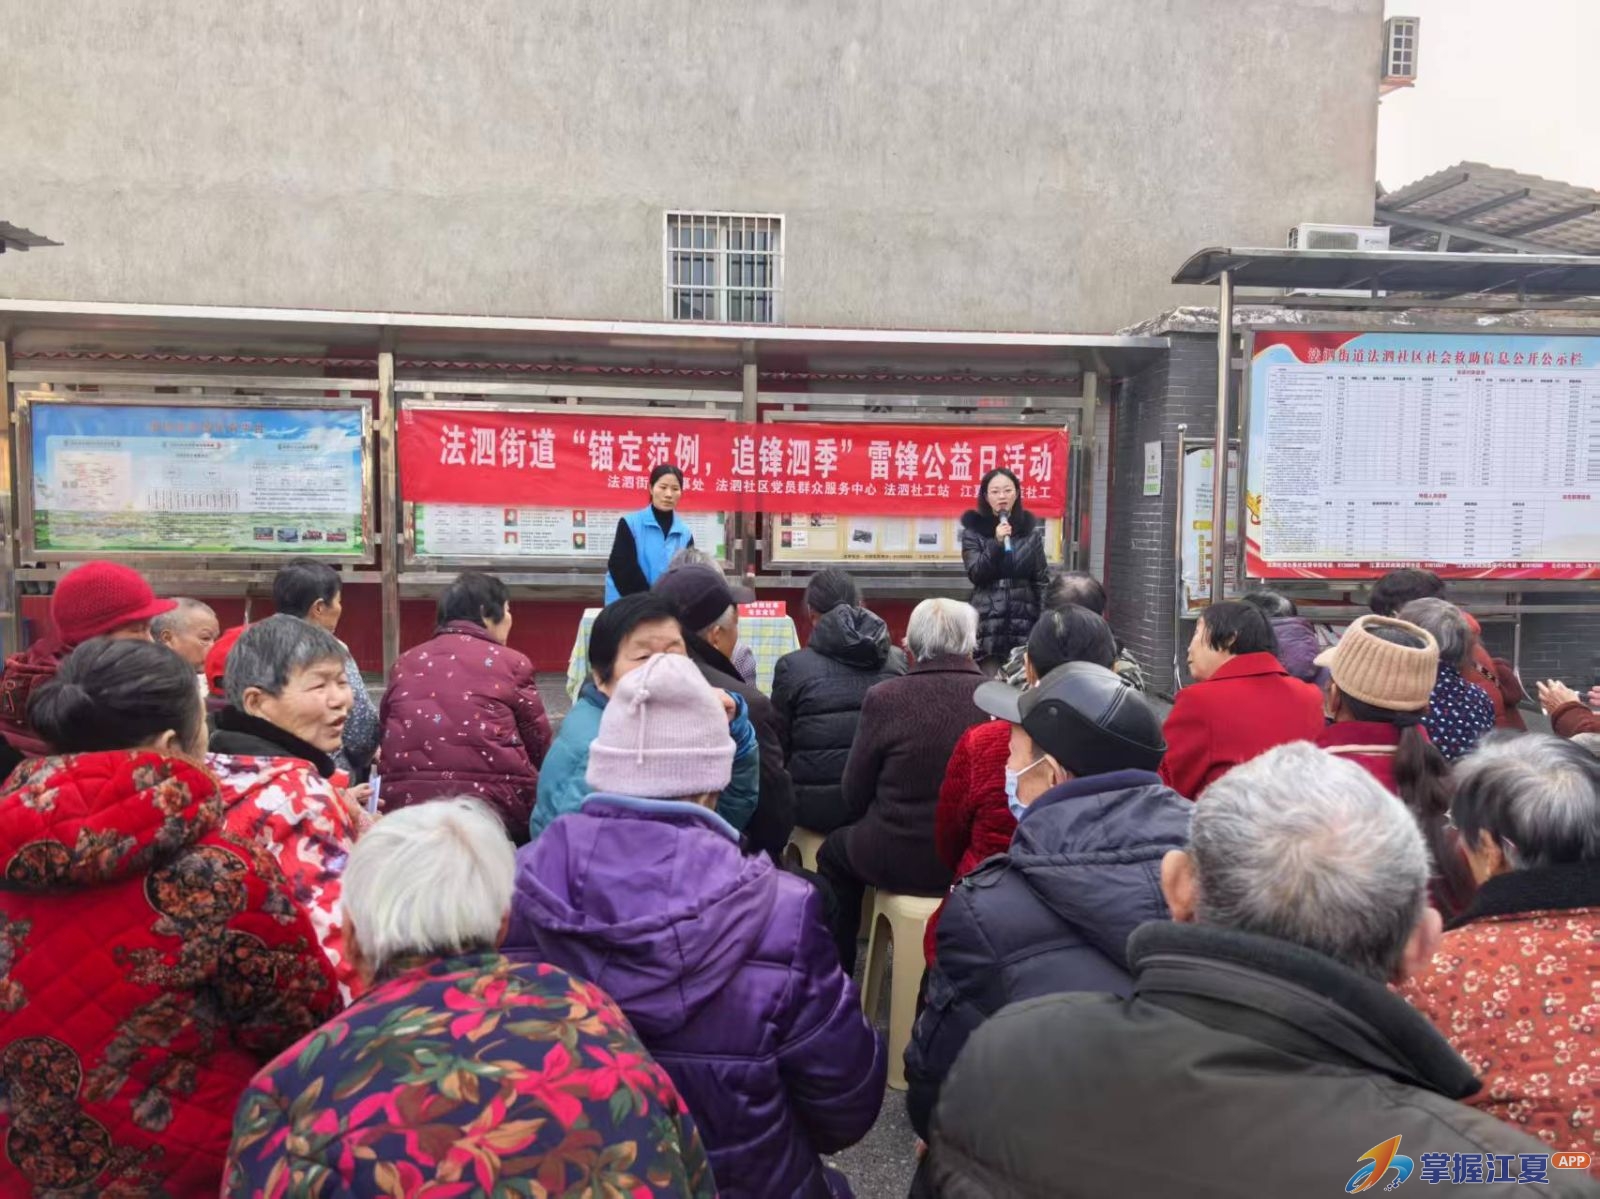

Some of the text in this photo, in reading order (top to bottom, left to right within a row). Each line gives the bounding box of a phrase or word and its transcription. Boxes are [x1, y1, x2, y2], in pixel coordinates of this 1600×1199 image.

[715, 478, 877, 496] 法泗社区党员群众服务中心
[883, 482, 950, 498] 法泗社工站
